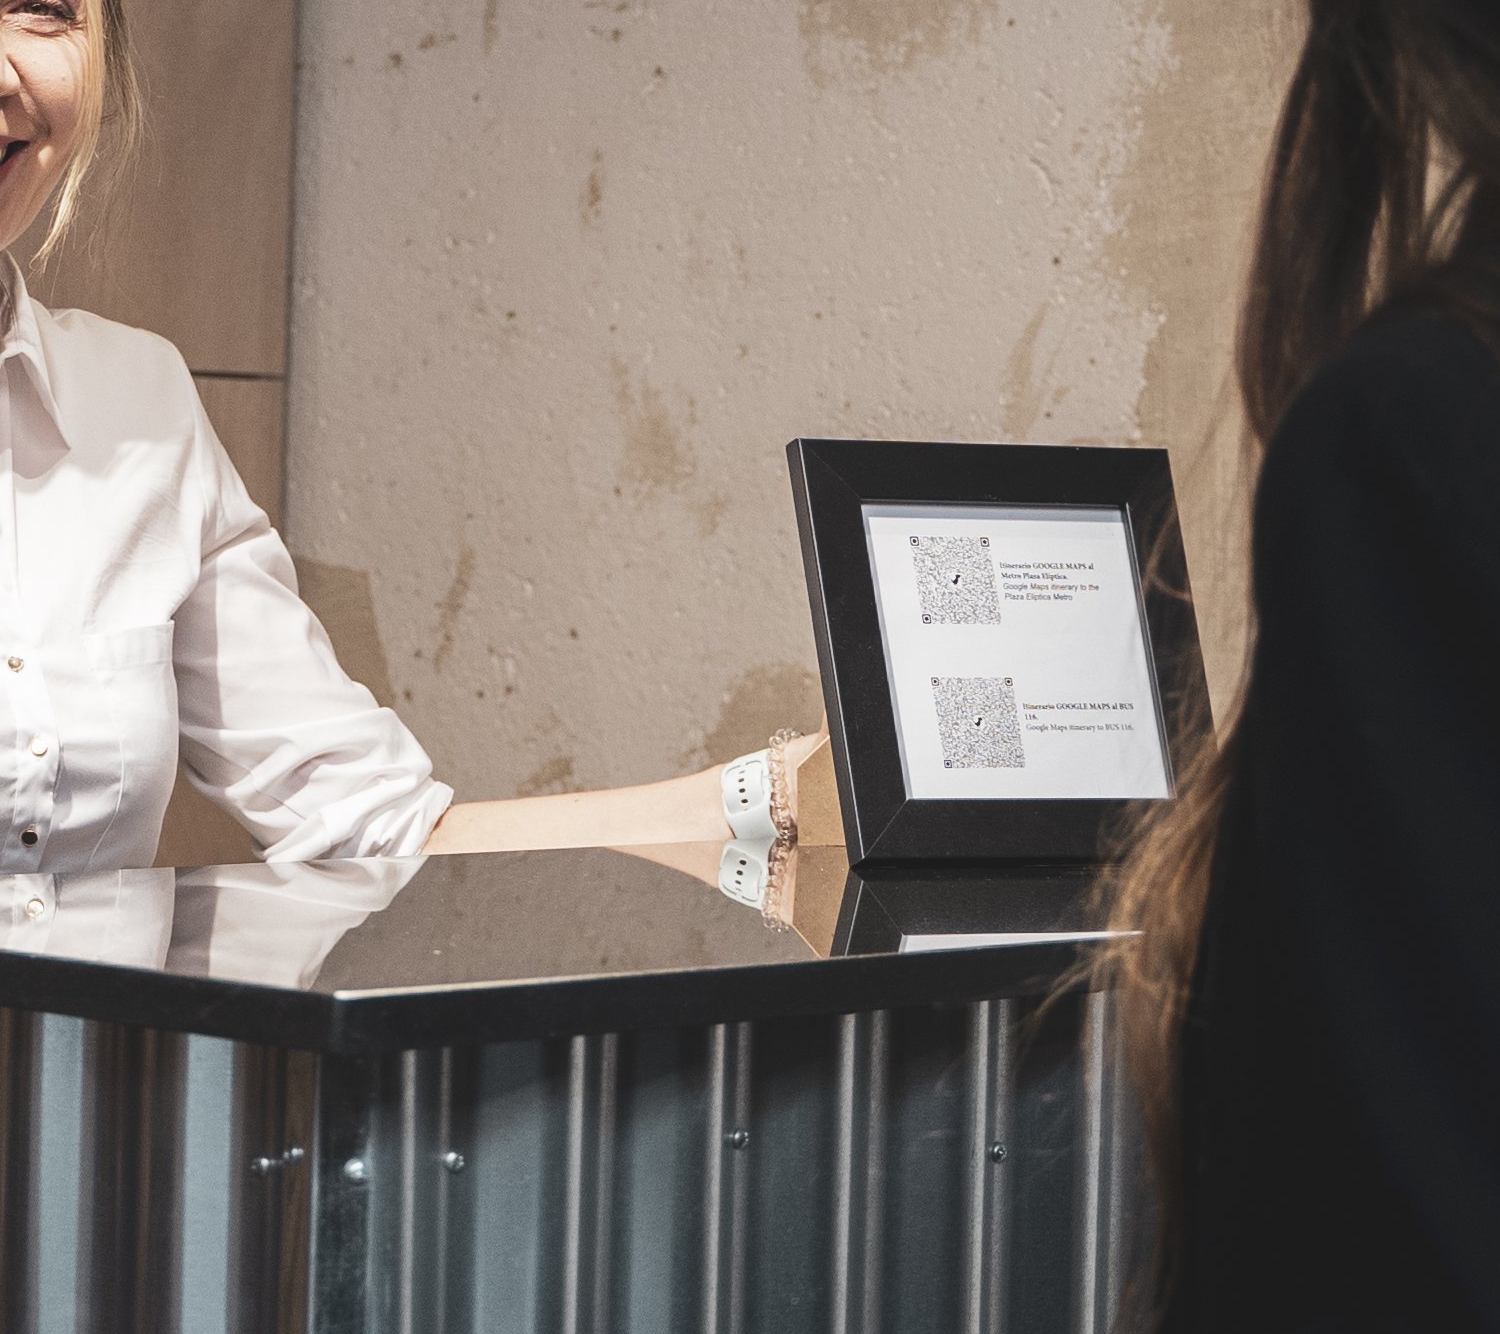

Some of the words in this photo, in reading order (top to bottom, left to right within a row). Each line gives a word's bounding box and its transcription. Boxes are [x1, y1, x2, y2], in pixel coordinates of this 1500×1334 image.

[1003, 583, 1028, 591] Google
[1030, 583, 1049, 591] Maps
[1025, 724, 1048, 732] Google
[1050, 724, 1068, 732] Maps
